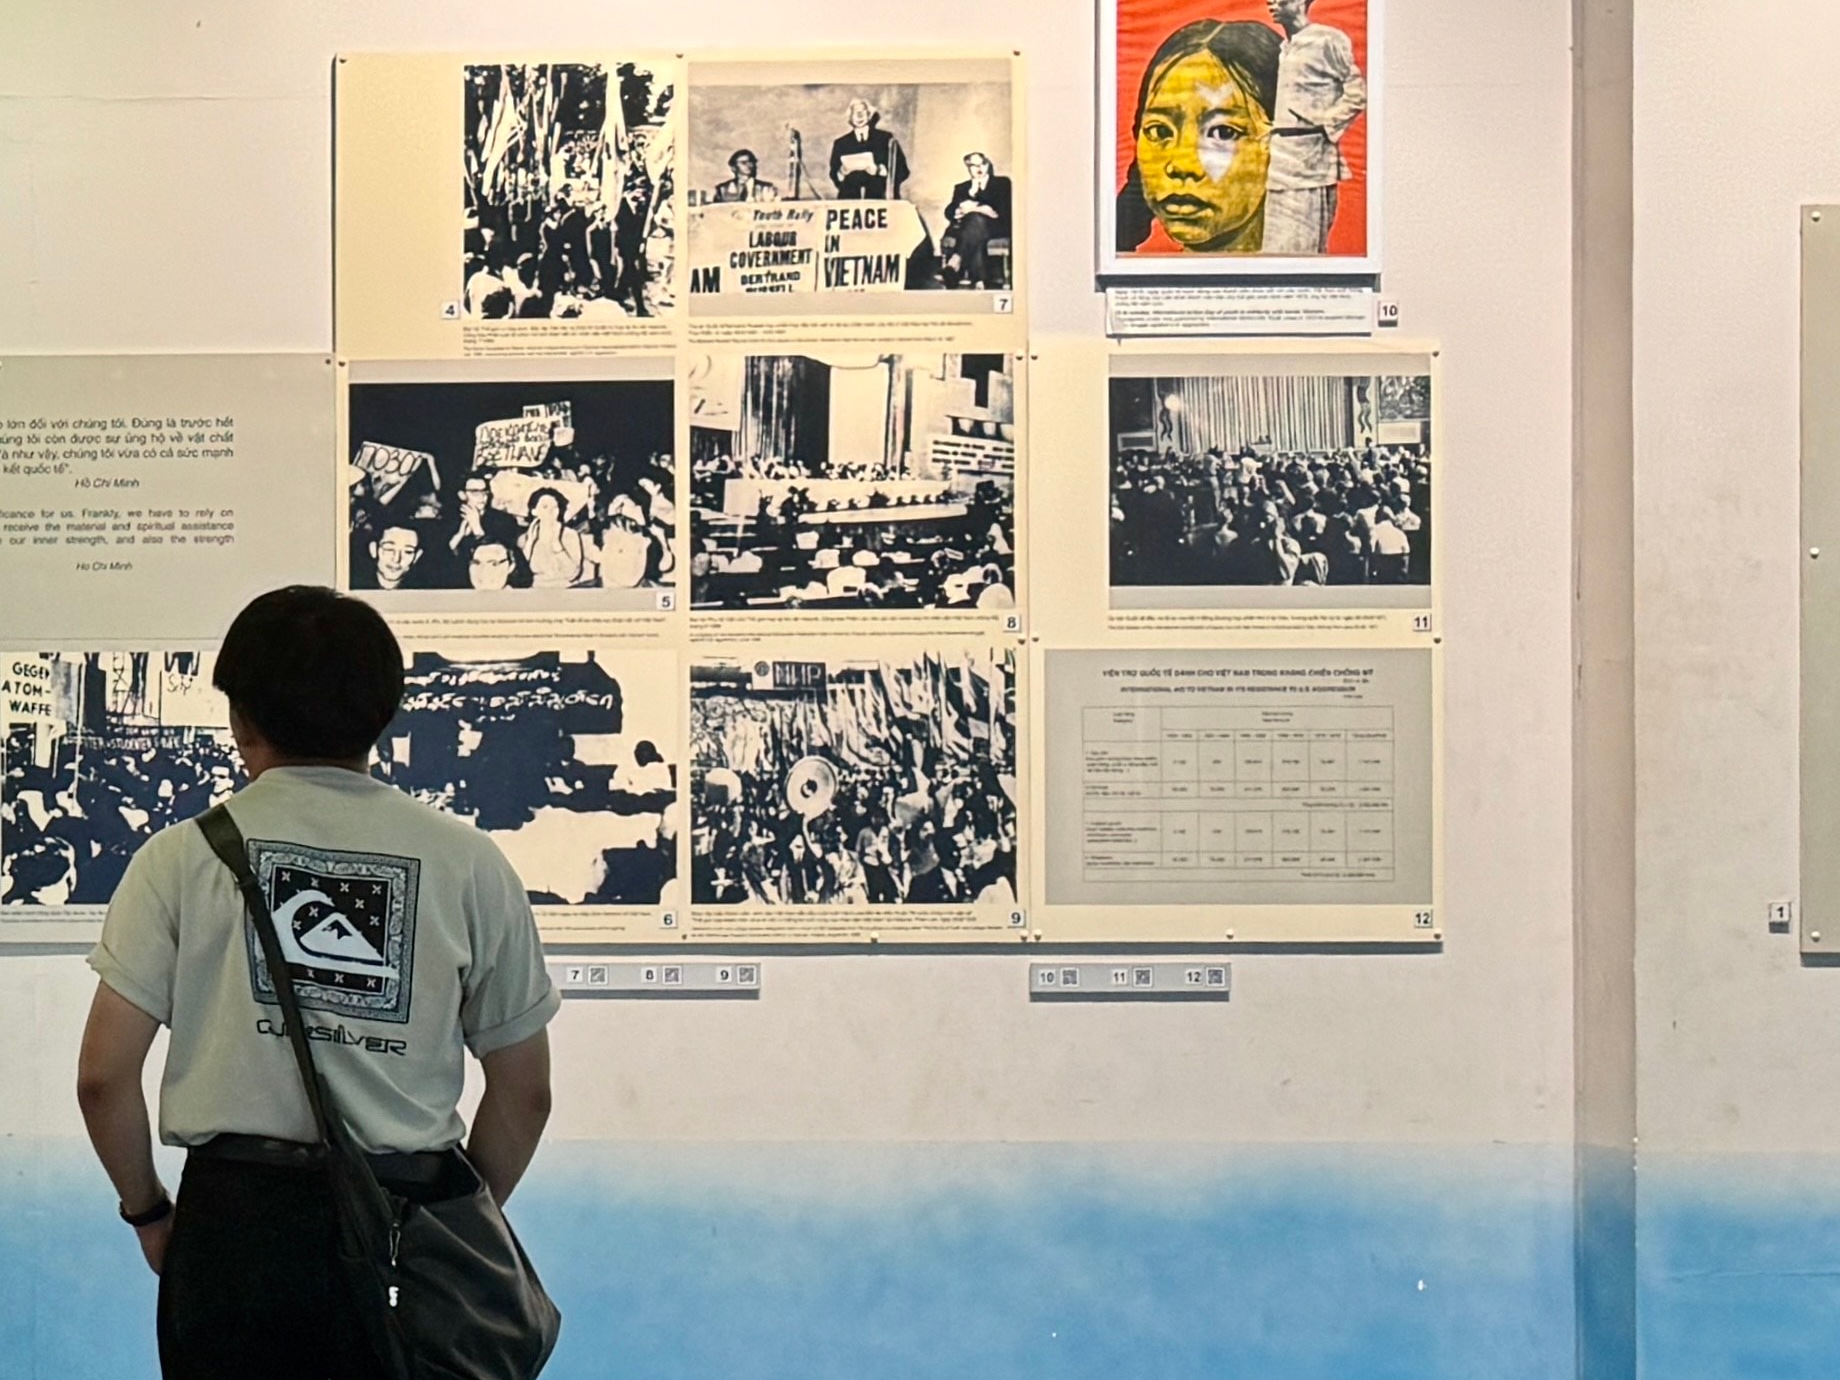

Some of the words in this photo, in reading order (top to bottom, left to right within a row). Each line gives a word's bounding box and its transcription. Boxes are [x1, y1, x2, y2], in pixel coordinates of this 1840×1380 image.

[826, 208, 888, 231] PEACE
[749, 231, 797, 248] LABOUR
[824, 235, 840, 253] IN
[730, 248, 813, 269] GOVERNMENT
[824, 254, 900, 288] VIETNAM
[740, 270, 800, 286] BERTRAND
[445, 304, 455, 316] 4
[999, 298, 1008, 310] 7
[1382, 304, 1399, 317] 10
[660, 595, 671, 608] 5
[1009, 616, 1018, 629] 8
[1414, 616, 1429, 628] 11
[1012, 912, 1022, 924] 9
[1416, 912, 1431, 924] 12
[1777, 906, 1785, 918] 1
[664, 914, 674, 925] 6
[571, 970, 580, 980] 7
[646, 970, 654, 980] 8
[721, 970, 730, 980] 9
[1040, 972, 1054, 982] 10
[1115, 973, 1126, 982] 11
[1187, 972, 1201, 983] 12
